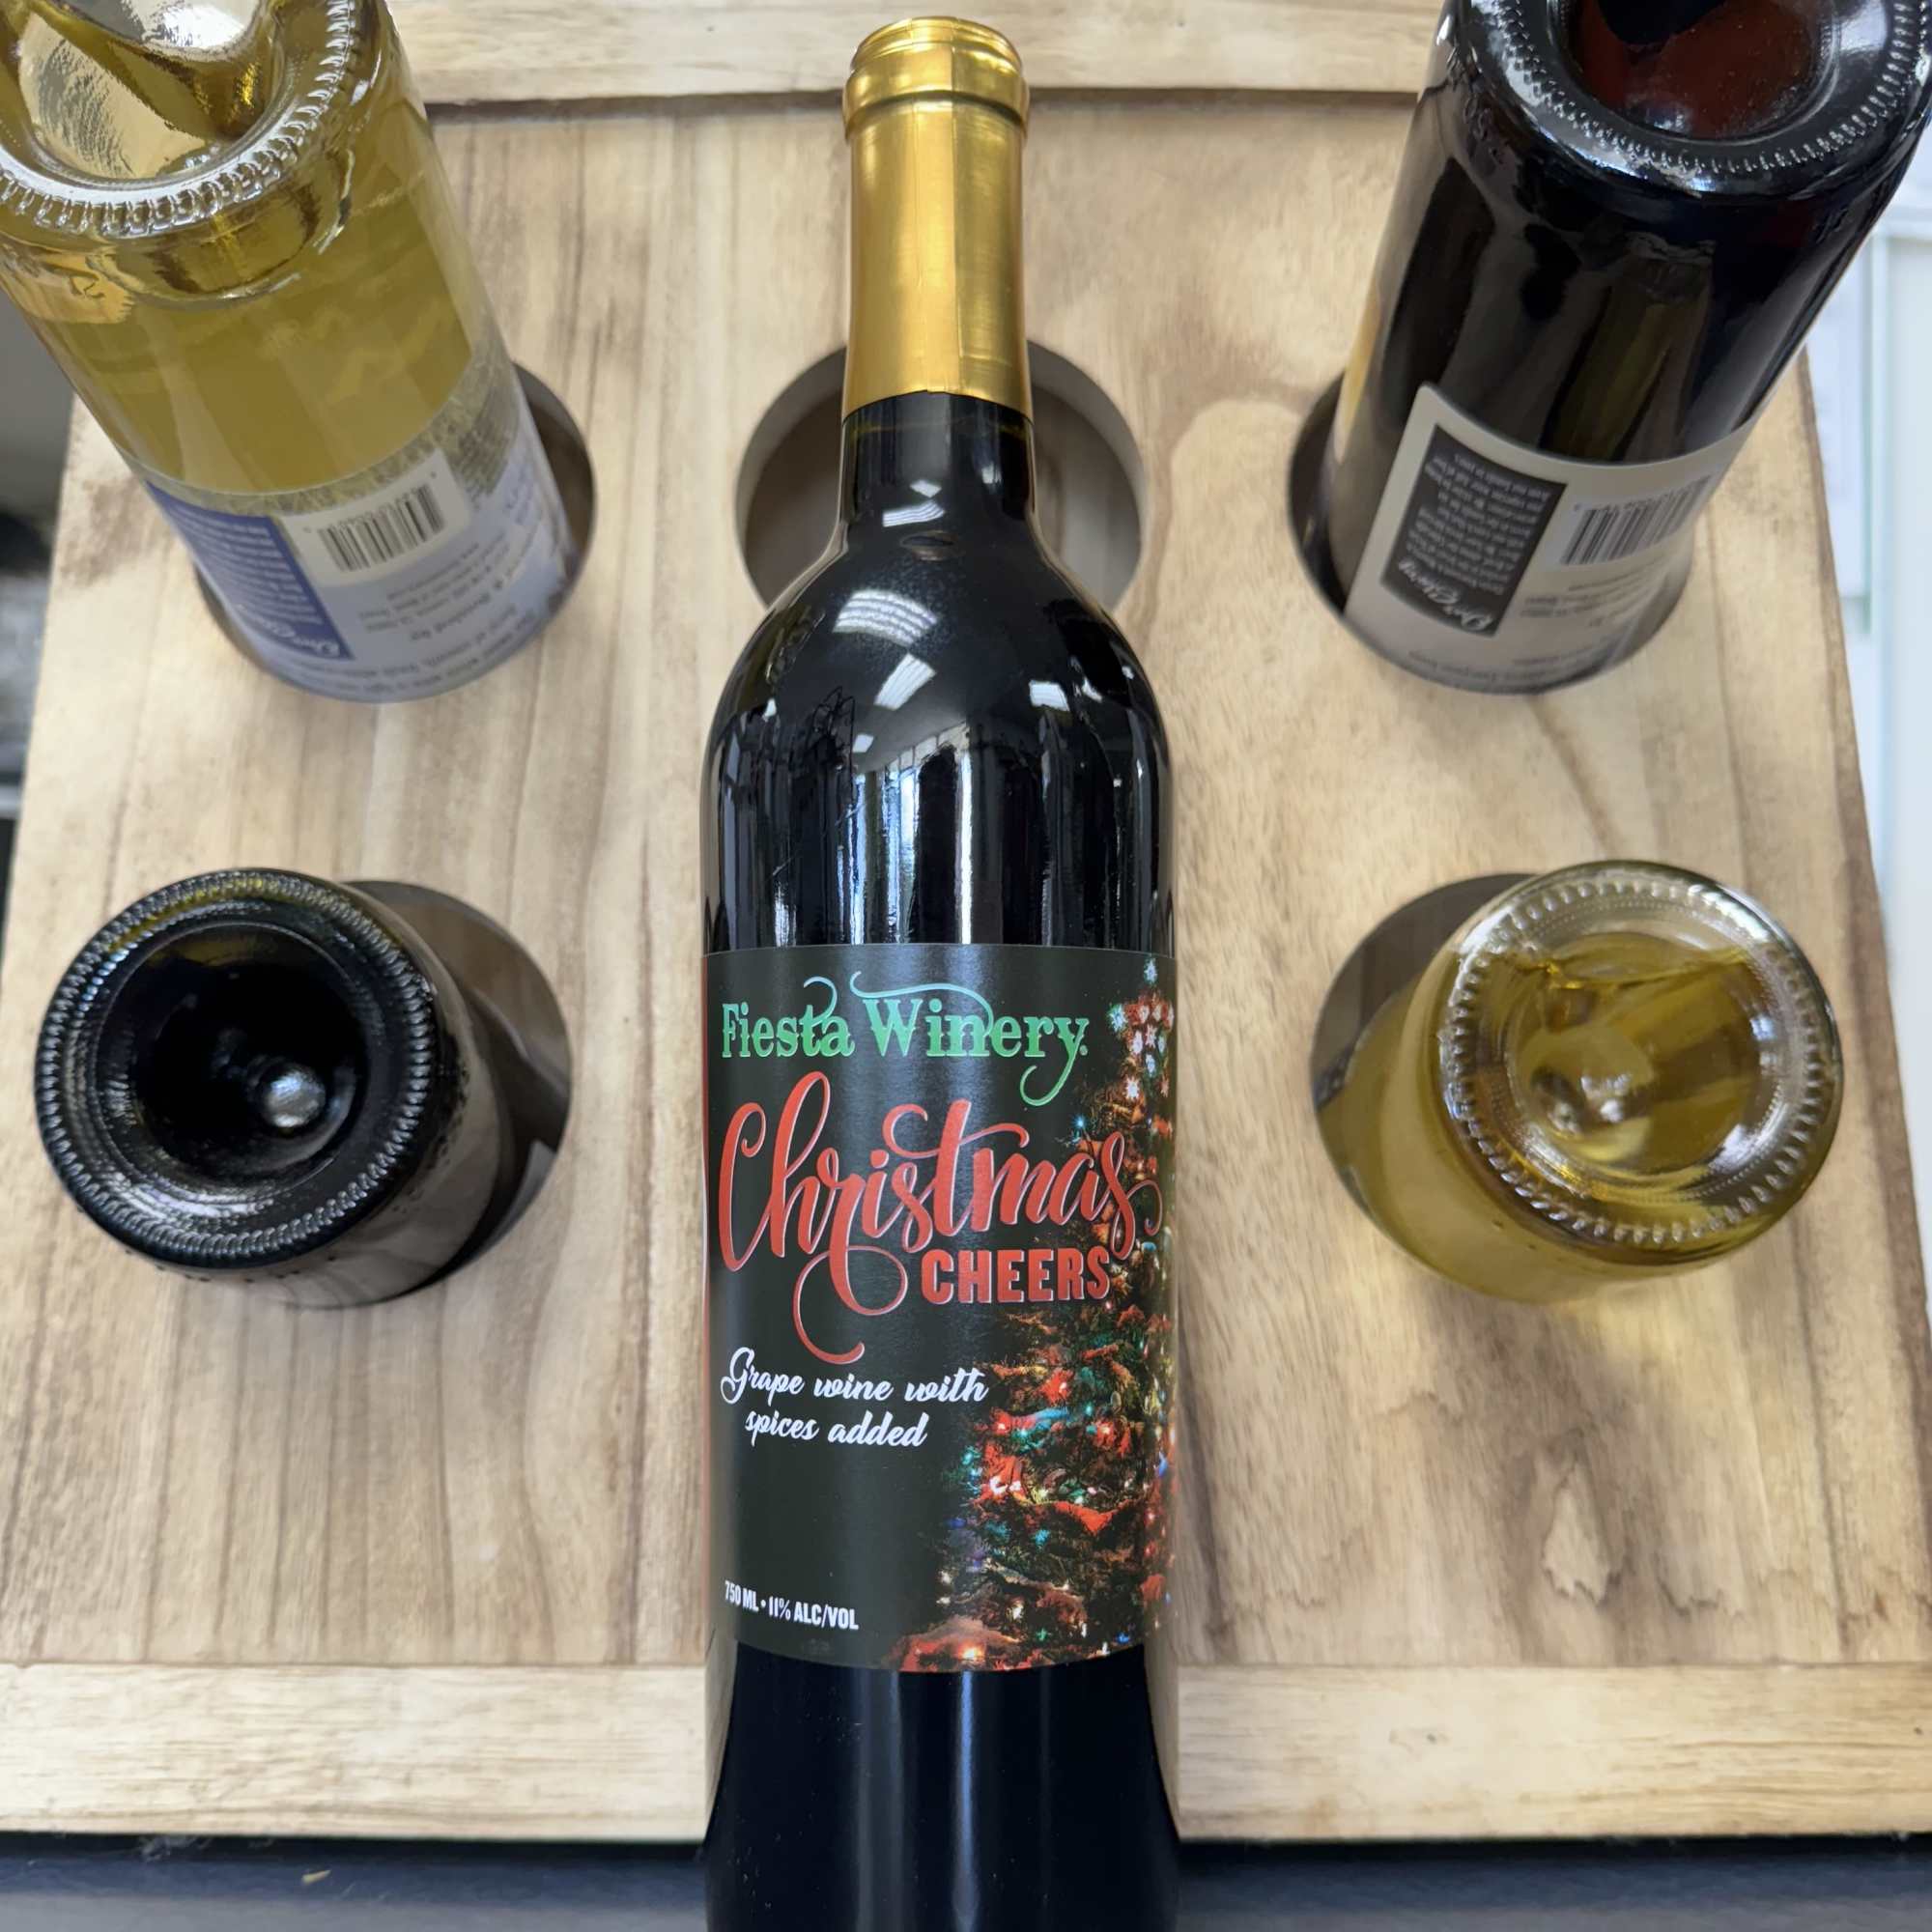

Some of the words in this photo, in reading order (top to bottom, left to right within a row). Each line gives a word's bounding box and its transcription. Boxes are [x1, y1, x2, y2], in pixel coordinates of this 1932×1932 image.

[721, 975, 855, 1059] Fiesta
[718, 1070, 1162, 1364] Christmas
[920, 1245, 1111, 1305] CHEERS
[720, 1347, 805, 1406] Grape
[813, 1373, 894, 1401] wine
[904, 1367, 988, 1402] with
[745, 1409, 820, 1447] spices
[827, 1410, 929, 1446] added
[724, 1579, 742, 1605] 750
[742, 1587, 759, 1612] ML
[768, 1596, 791, 1621] 11%
[793, 1601, 860, 1631] ALC/VOL
